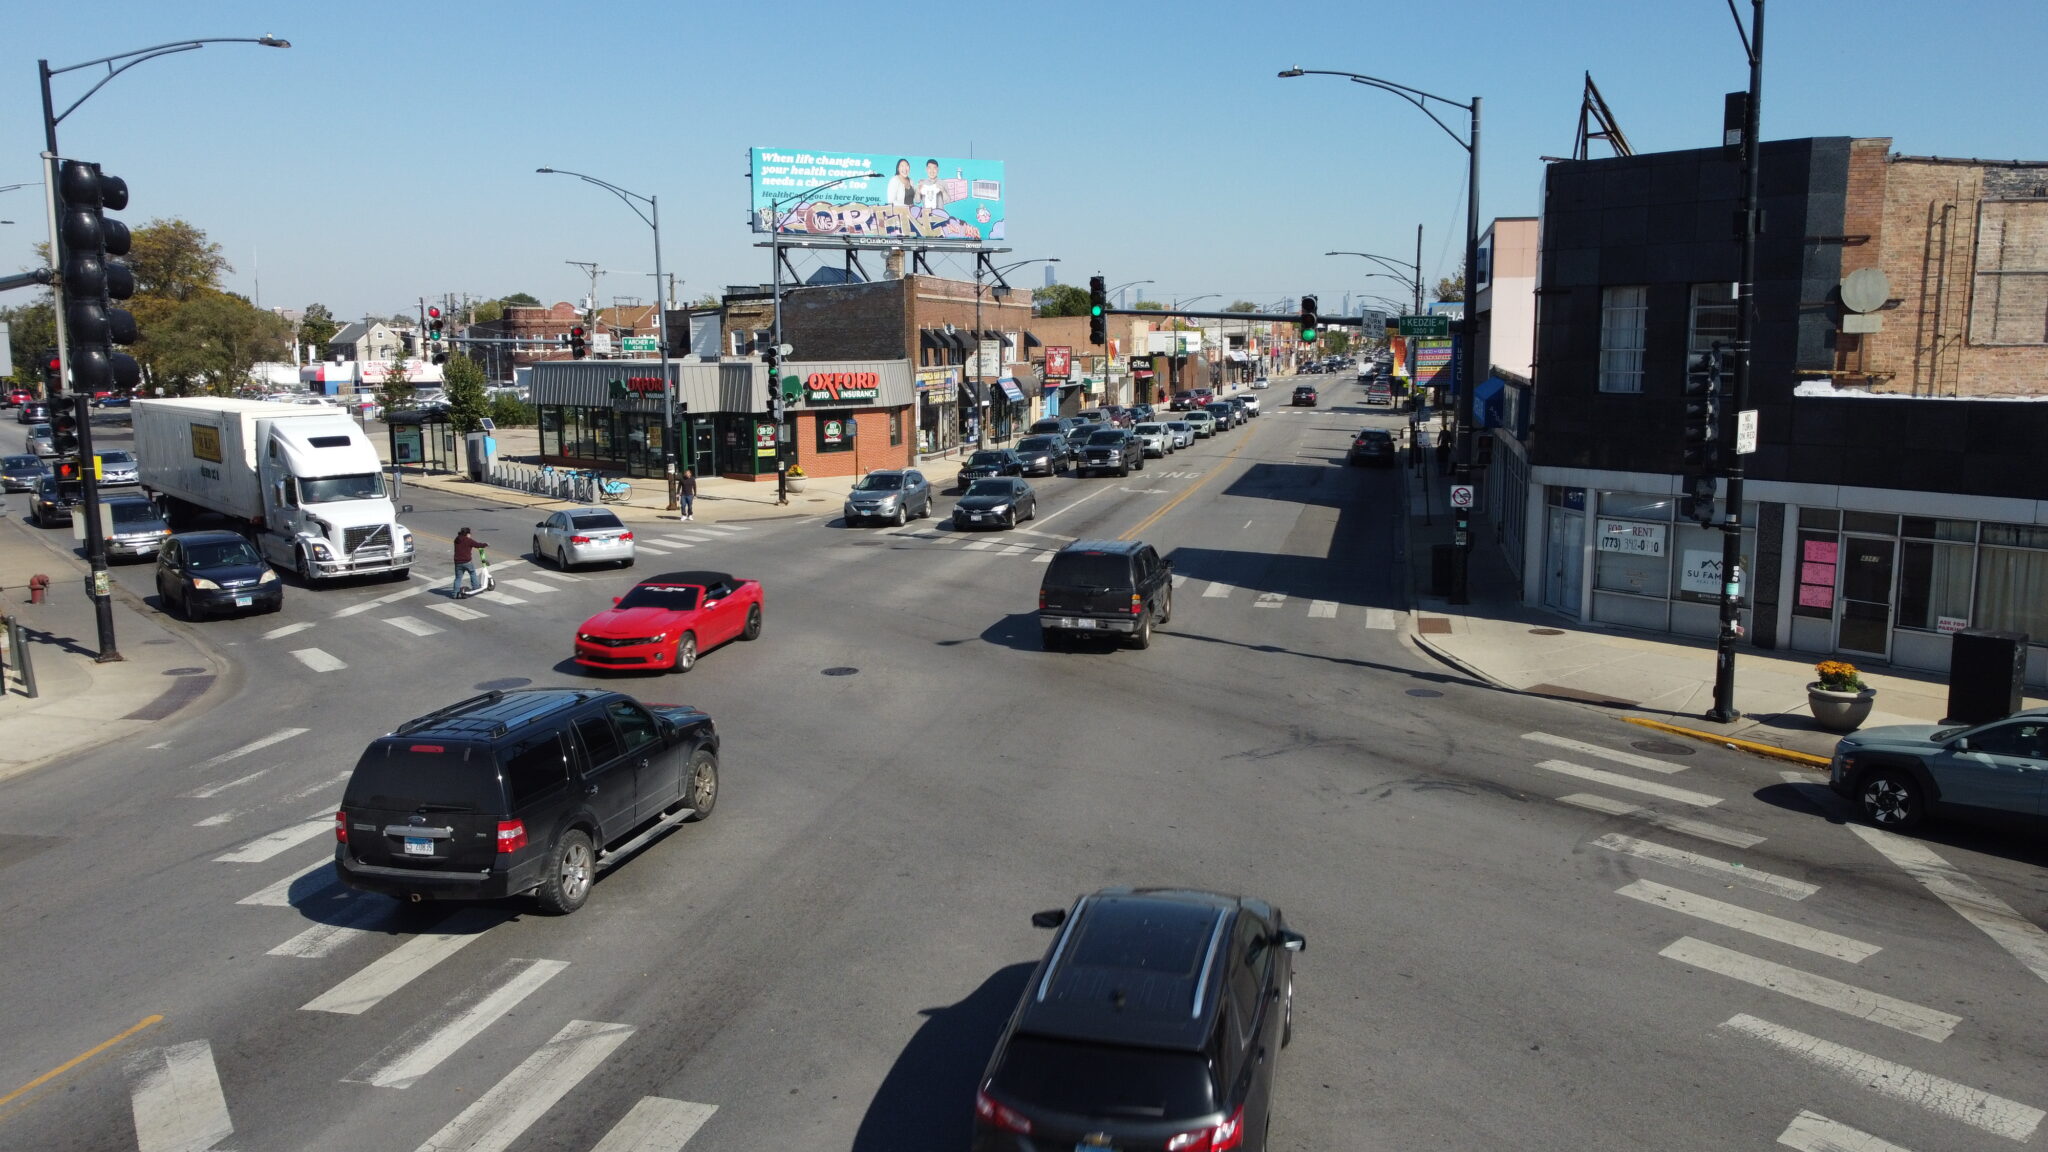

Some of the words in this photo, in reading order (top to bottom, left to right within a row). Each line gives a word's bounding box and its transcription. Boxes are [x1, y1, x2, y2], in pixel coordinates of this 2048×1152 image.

[761, 152, 794, 163] When
[795, 153, 815, 164] life
[815, 155, 860, 168] changes
[862, 158, 872, 168] &
[761, 165, 789, 176] your
[790, 165, 826, 176] health
[762, 176, 794, 186] needs
[849, 180, 868, 189] too
[1407, 318, 1436, 326] KEDZIE
[809, 372, 880, 400] OXFORD
[1608, 524, 1622, 534] FOR
[1632, 526, 1654, 537] RENT
[1602, 536, 1621, 550] (773)
[1687, 570, 1699, 578] SU
